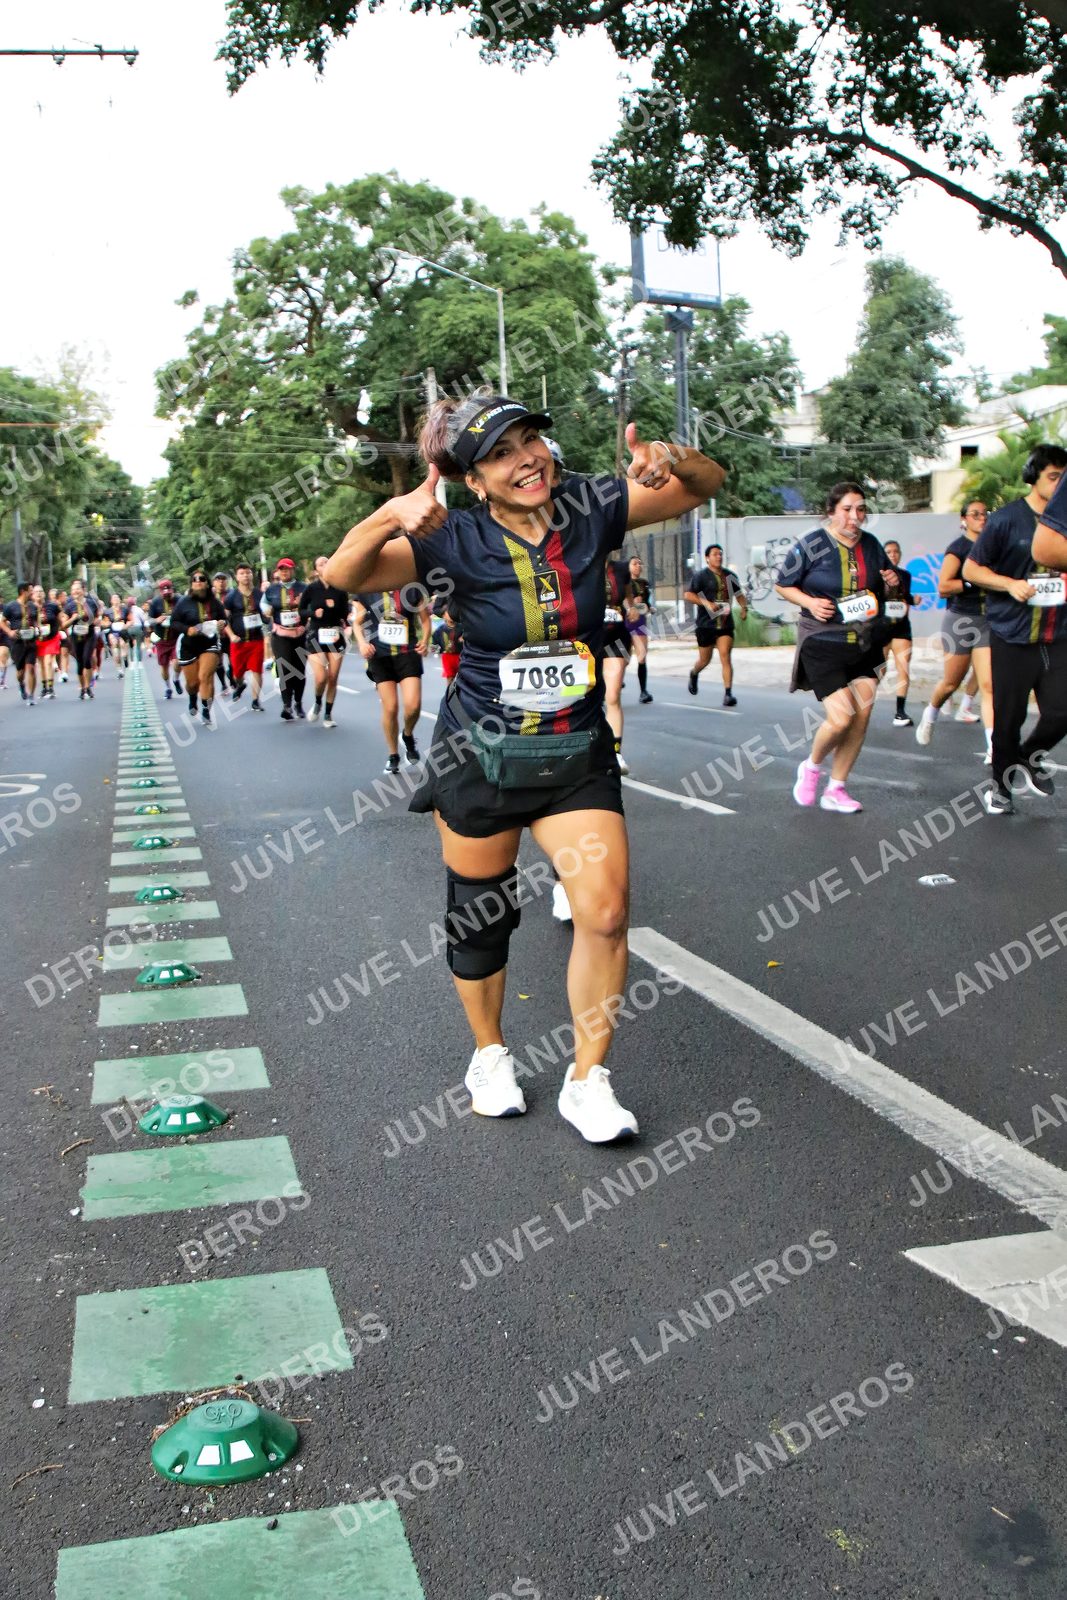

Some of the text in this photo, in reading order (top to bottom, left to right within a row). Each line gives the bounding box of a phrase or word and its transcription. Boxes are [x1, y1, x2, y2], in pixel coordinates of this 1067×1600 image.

[1031, 583, 1062, 593] 0622
[847, 600, 870, 614] 4605
[383, 627, 403, 635] 7377
[512, 664, 576, 690] 7086
